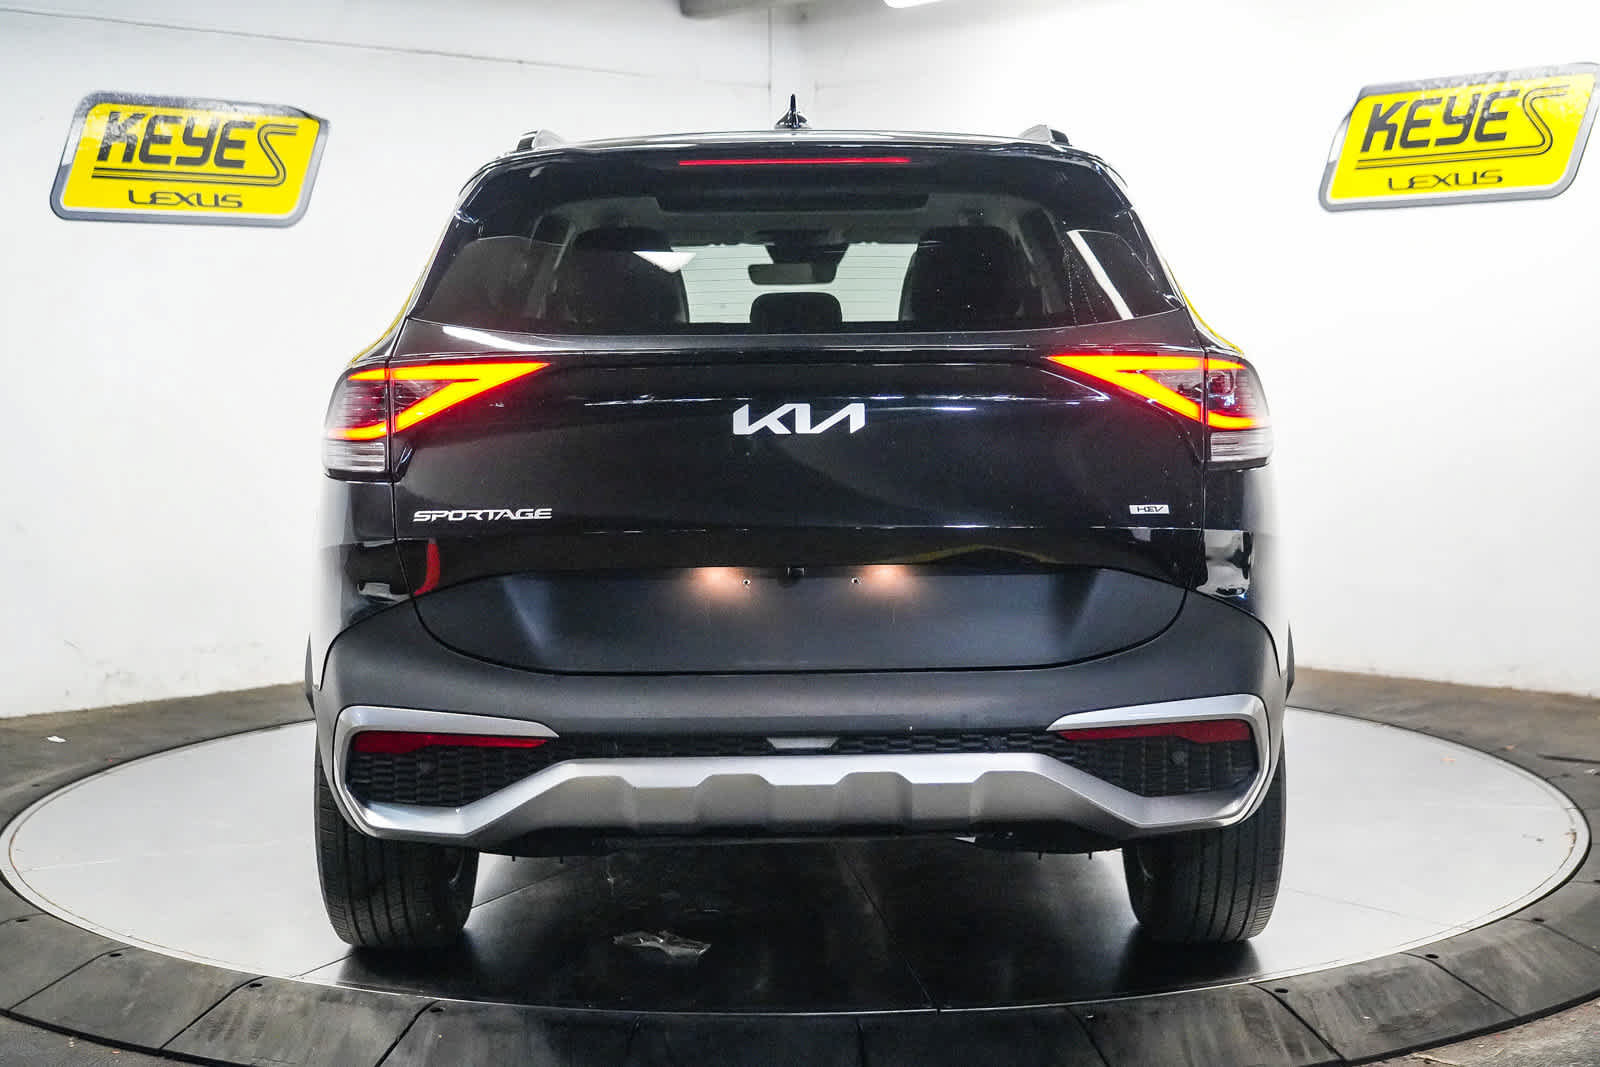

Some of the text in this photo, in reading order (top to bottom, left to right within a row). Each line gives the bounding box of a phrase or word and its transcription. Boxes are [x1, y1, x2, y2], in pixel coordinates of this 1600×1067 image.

[1355, 84, 1570, 166] KEYES
[92, 110, 298, 187] KEYES
[1388, 168, 1503, 191] LEXUS
[127, 189, 243, 209] LEXUS
[733, 403, 865, 435] KIA
[412, 507, 553, 522] SPORTAGE
